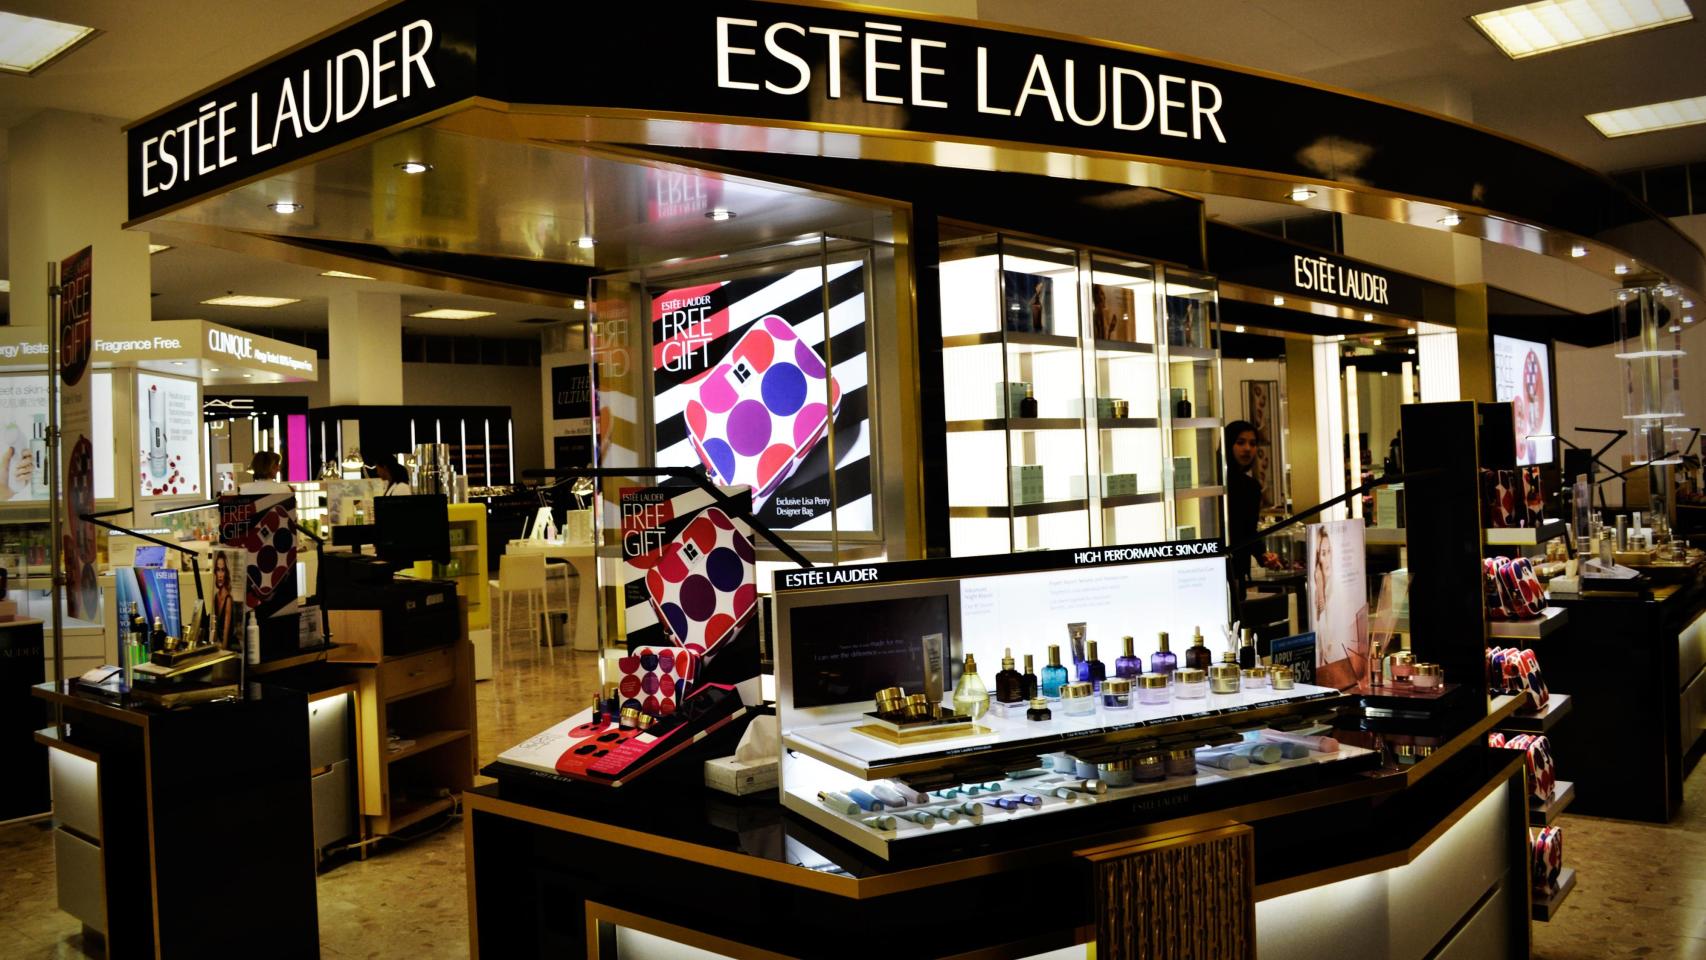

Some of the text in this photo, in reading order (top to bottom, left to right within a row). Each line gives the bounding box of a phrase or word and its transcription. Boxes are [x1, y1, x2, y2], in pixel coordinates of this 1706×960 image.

[250, 19, 437, 156] LAUDER
[976, 46, 1227, 144] LAUDER
[62, 273, 90, 321] FREE
[1338, 266, 1389, 306] LAUDER
[682, 295, 711, 308] LAUDER
[661, 306, 712, 342] FREE
[62, 318, 90, 367] GIFT
[95, 339, 152, 353] Fragrance
[153, 337, 182, 349] Free.
[208, 329, 253, 360] CLINIQUE
[661, 337, 712, 372] GIFT
[641, 492, 664, 502] LAUDER
[776, 496, 830, 507] Exclusive Lisa Perry
[223, 504, 252, 523] FREE
[623, 502, 665, 530] FREE
[776, 507, 814, 517] Designer Bag
[223, 521, 252, 540] GIFT
[623, 530, 666, 558] GIFT
[1074, 542, 1219, 564] HIGH PERFORMANCE SKINCARE
[826, 568, 878, 585] LAUDER
[1275, 650, 1293, 665] APPLY
[1290, 660, 1311, 683] 5%
